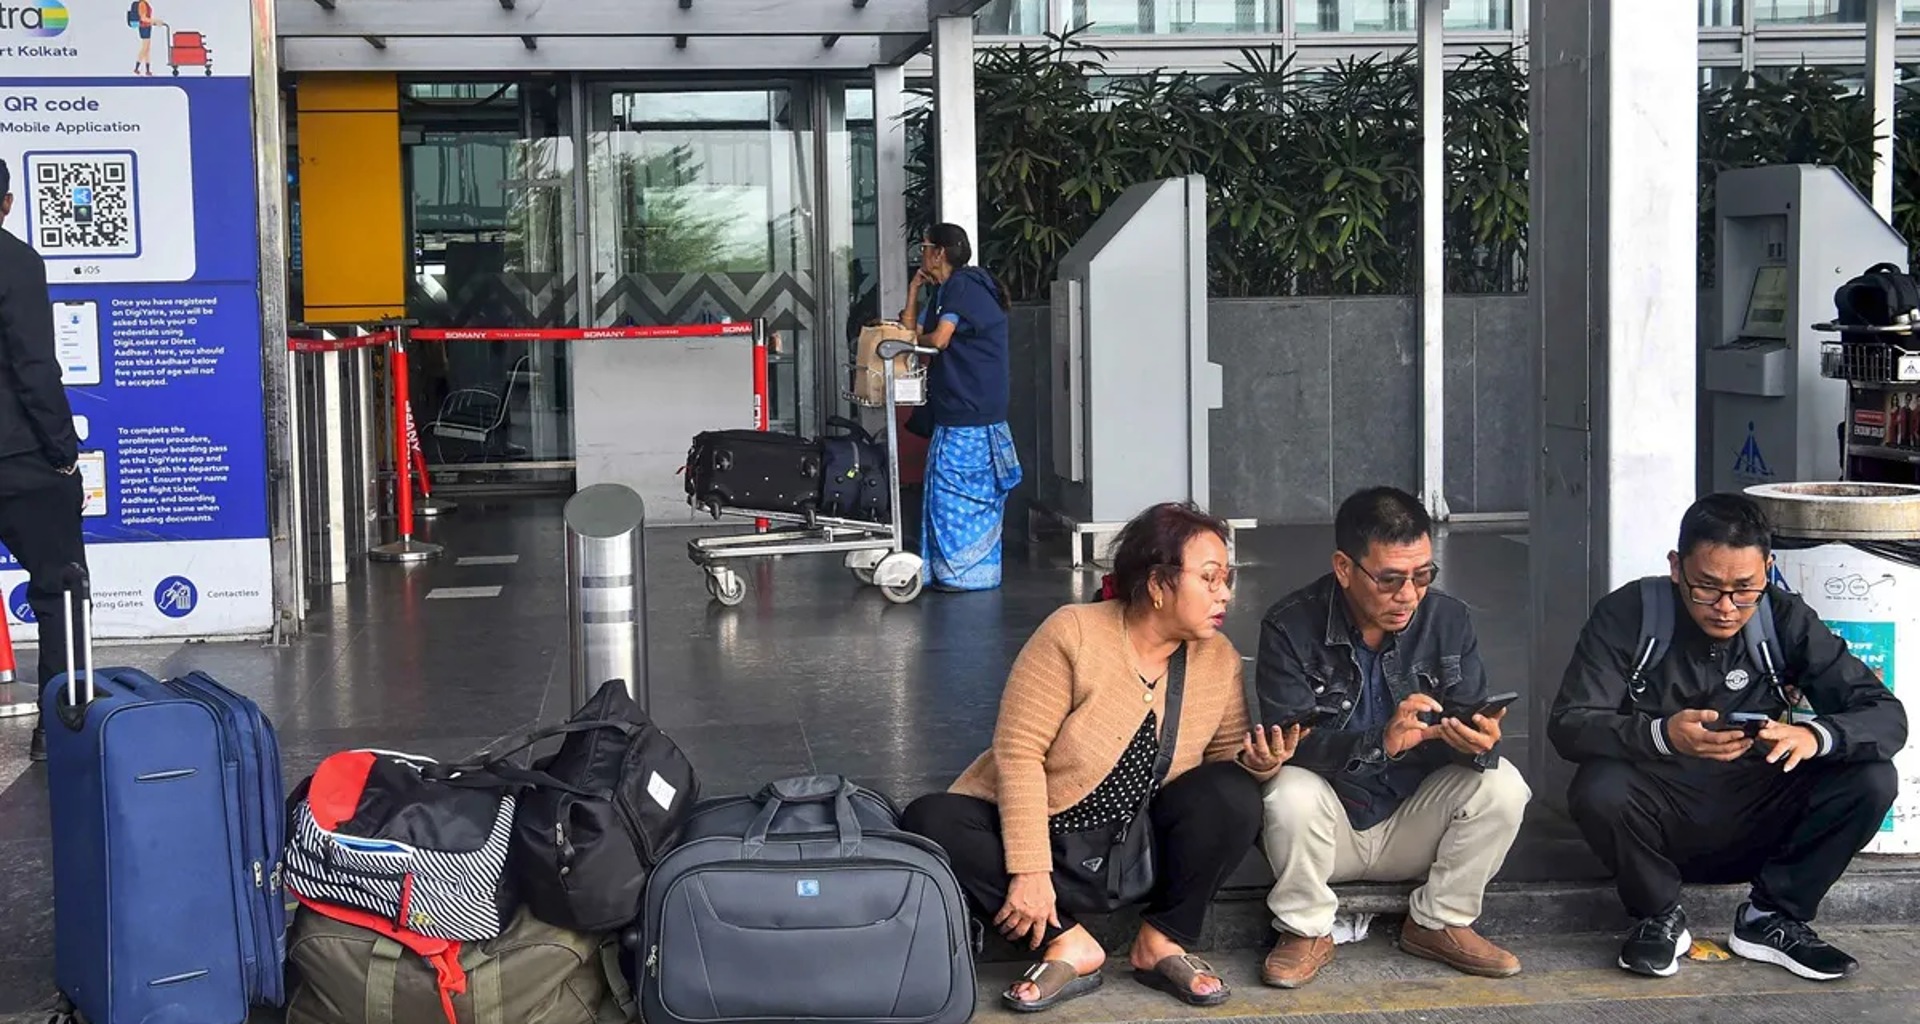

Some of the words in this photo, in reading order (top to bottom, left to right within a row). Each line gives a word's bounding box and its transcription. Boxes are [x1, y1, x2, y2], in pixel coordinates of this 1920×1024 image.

[18, 45, 78, 57] Kolkata
[4, 96, 38, 112] QR
[45, 96, 99, 111] code
[0, 121, 51, 132] Mobile
[55, 121, 140, 135] Application
[84, 265, 101, 275] iOS
[112, 298, 134, 306] Once
[136, 300, 151, 308] you
[153, 298, 173, 306] have
[174, 297, 217, 307] registered
[125, 308, 167, 318] DigiYatra,
[169, 309, 185, 317] you
[186, 307, 201, 315] will
[202, 307, 213, 315] be
[113, 318, 138, 326] asked
[139, 318, 149, 326] to
[150, 318, 165, 326] link
[166, 319, 186, 327] your
[113, 328, 159, 336] credentials
[161, 328, 183, 338] using
[444, 331, 487, 339] SOMANY
[583, 330, 625, 339] SOMANY
[113, 338, 159, 348] DigiLocker
[171, 338, 196, 346] Direct
[114, 348, 153, 356] Aadhaar.
[154, 348, 177, 357] Here,
[196, 347, 224, 355] should
[115, 358, 134, 366] note
[136, 358, 154, 366] that
[155, 358, 190, 366] Aadhaar
[132, 370, 155, 378] years
[156, 368, 165, 376] of
[167, 370, 182, 378] age
[184, 368, 199, 376] will
[128, 378, 168, 388] accepted.
[130, 426, 169, 436] complete
[171, 426, 185, 434] the
[118, 436, 164, 444] enrollment
[166, 436, 211, 446] procedure,
[119, 446, 148, 456] upload
[149, 448, 168, 456] your
[170, 446, 208, 456] boarding
[209, 447, 228, 455] pass
[132, 456, 146, 464] the
[148, 456, 187, 466] DigiYatra
[189, 457, 204, 465] app
[206, 455, 221, 463] and
[120, 466, 143, 474] share
[144, 466, 151, 474] it
[152, 466, 171, 474] with
[188, 465, 229, 475] departure
[120, 476, 150, 486] airport.
[153, 475, 182, 483] Ensure
[183, 477, 202, 485] your
[149, 485, 171, 495] flight
[173, 485, 199, 494] ticket,
[121, 495, 158, 505] Aadhaar,
[160, 495, 176, 503] and
[178, 495, 215, 505] boarding
[121, 507, 140, 515] pass
[156, 505, 171, 513] the
[121, 515, 164, 525] uploading
[165, 514, 214, 523] documents.
[92, 589, 142, 598] movement
[207, 589, 260, 599] Contactless
[94, 600, 116, 610] ding
[117, 599, 144, 608] Gates
